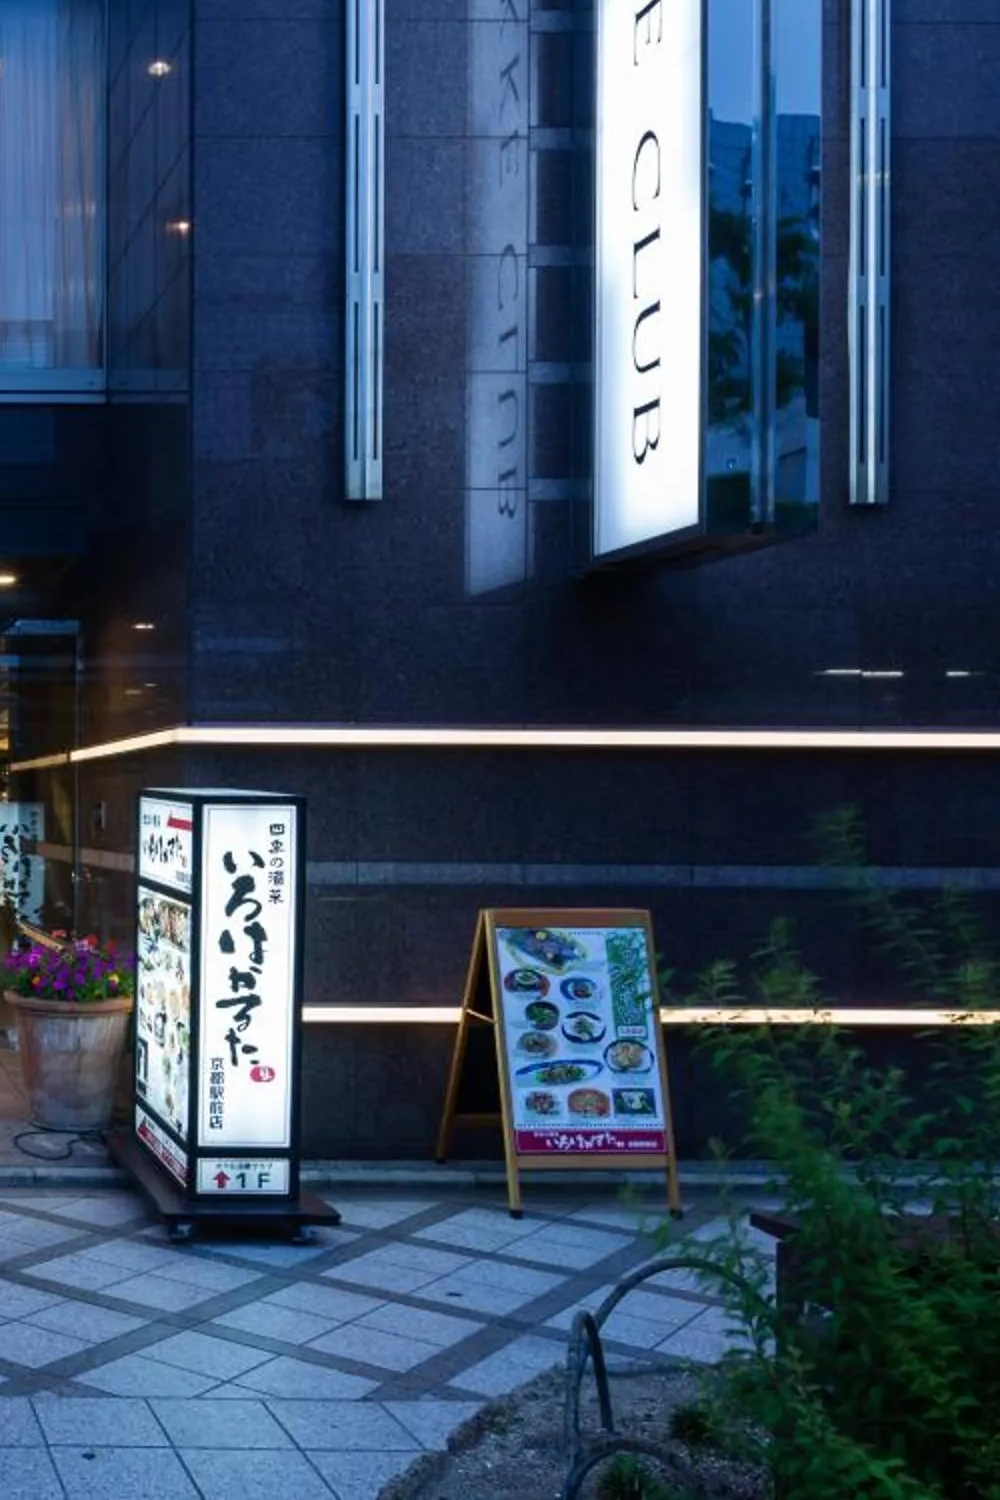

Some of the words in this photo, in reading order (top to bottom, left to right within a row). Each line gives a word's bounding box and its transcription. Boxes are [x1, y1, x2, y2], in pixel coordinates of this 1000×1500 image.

[633, 130, 661, 465] CLUB
[216, 850, 266, 1067] いろはかるた
[209, 1057, 225, 1130] 京都駅前店
